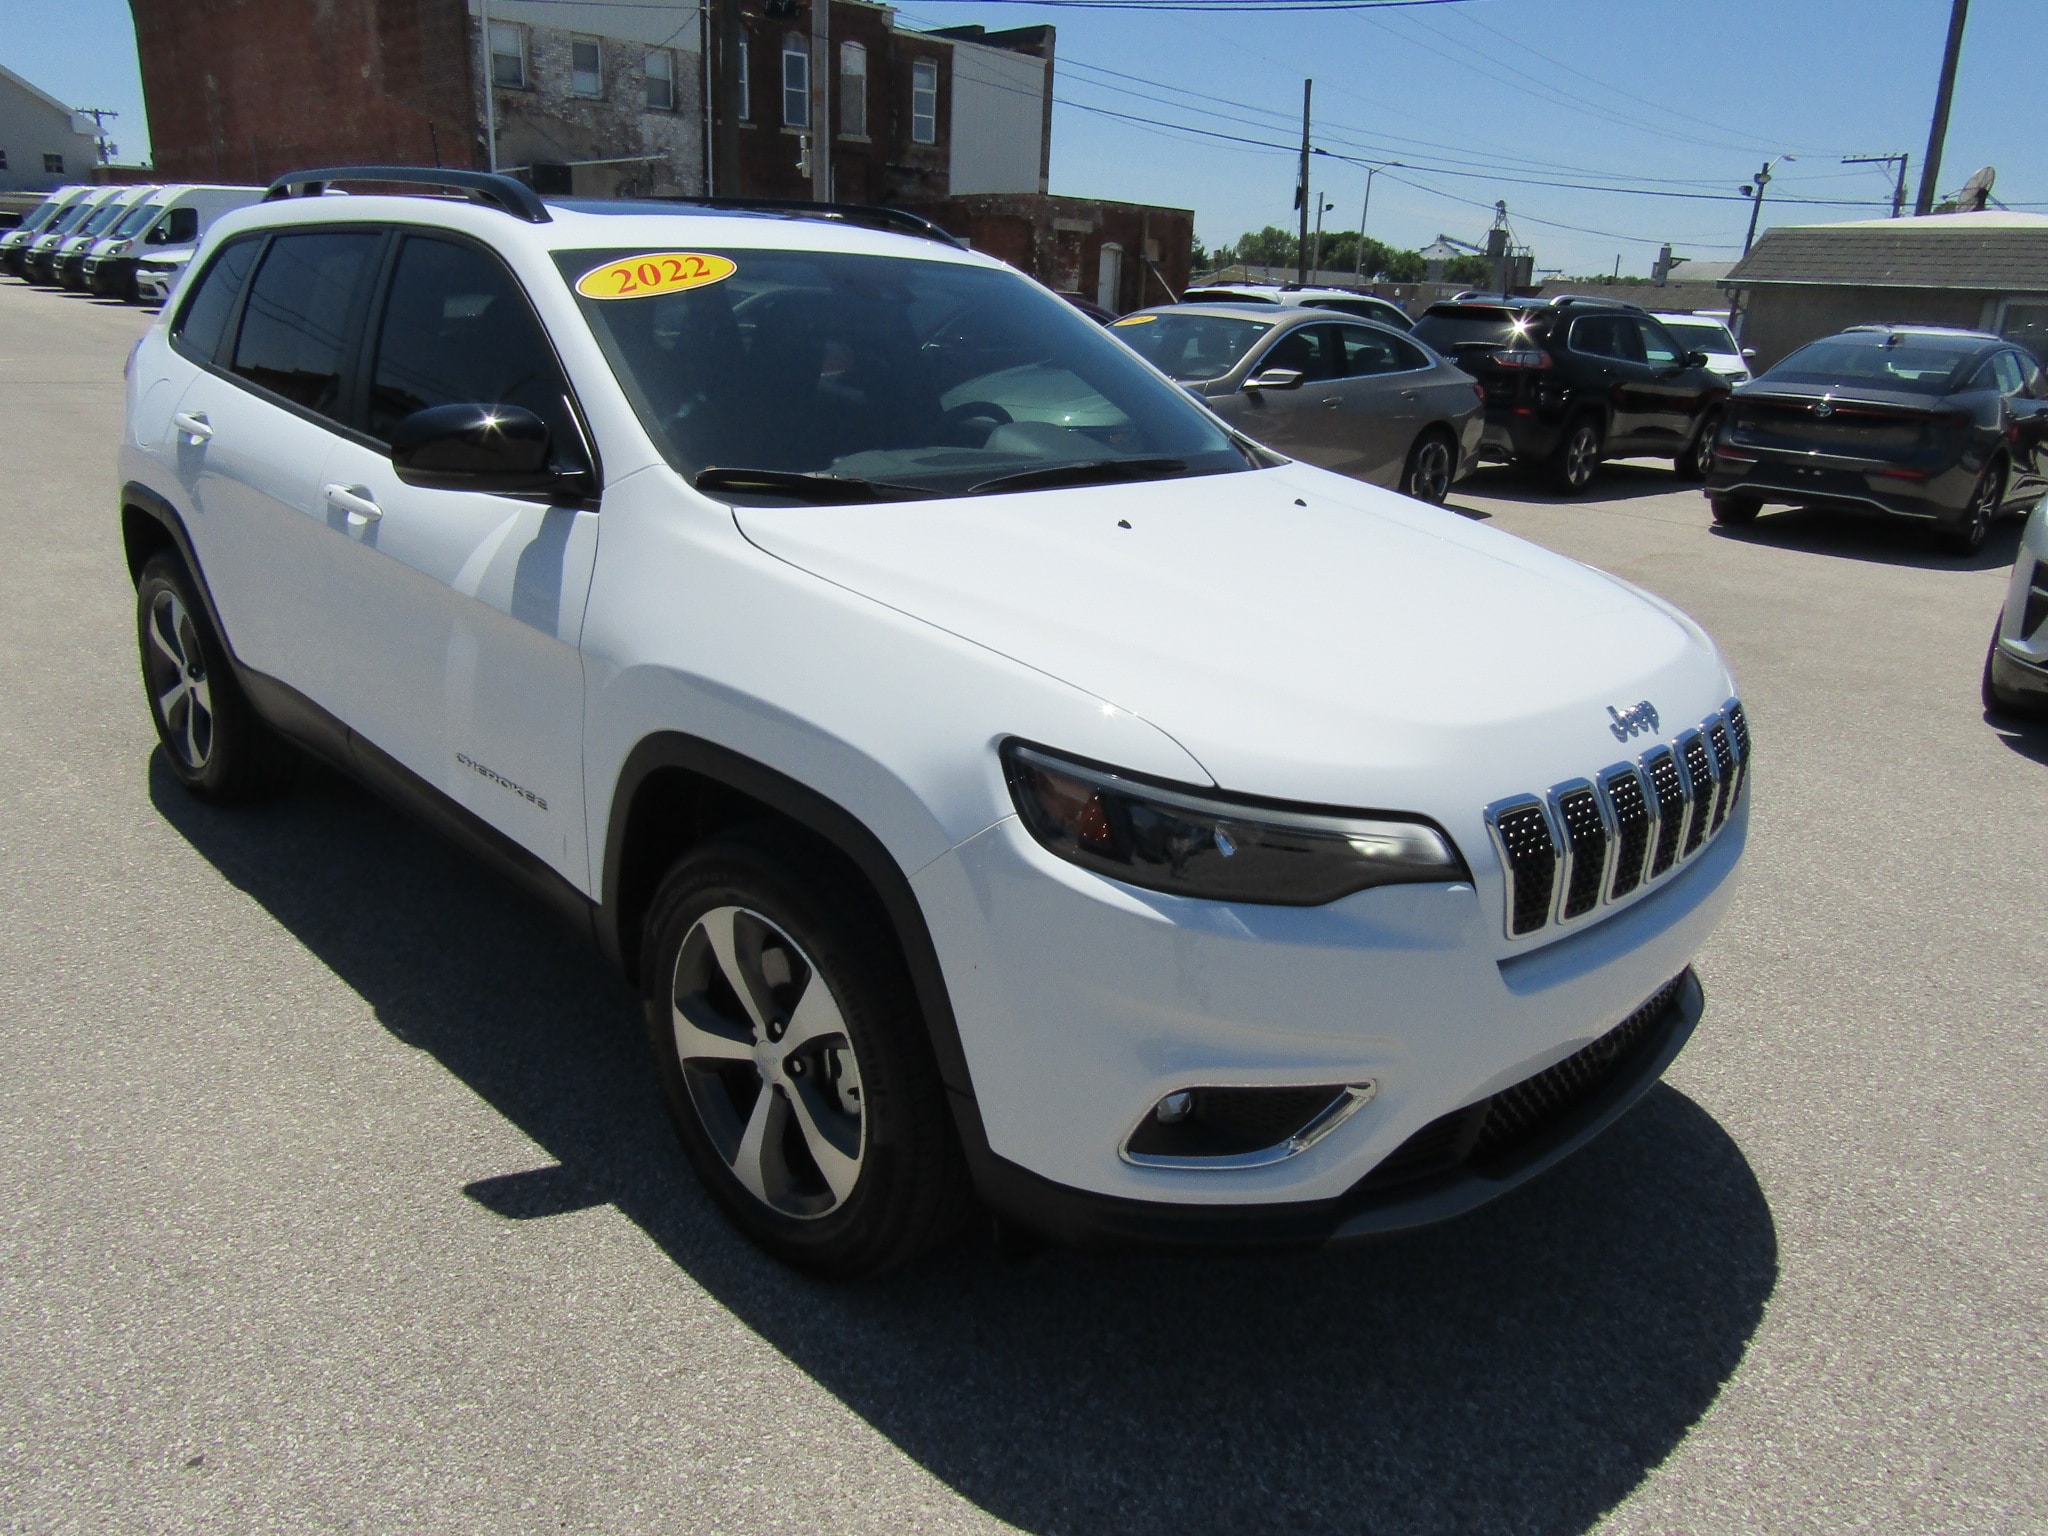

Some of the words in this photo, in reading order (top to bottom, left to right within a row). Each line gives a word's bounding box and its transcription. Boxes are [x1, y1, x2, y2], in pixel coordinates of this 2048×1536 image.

[611, 256, 711, 294] 2022
[1606, 700, 1660, 743] Jeep
[456, 753, 548, 811] CHEROKEE
